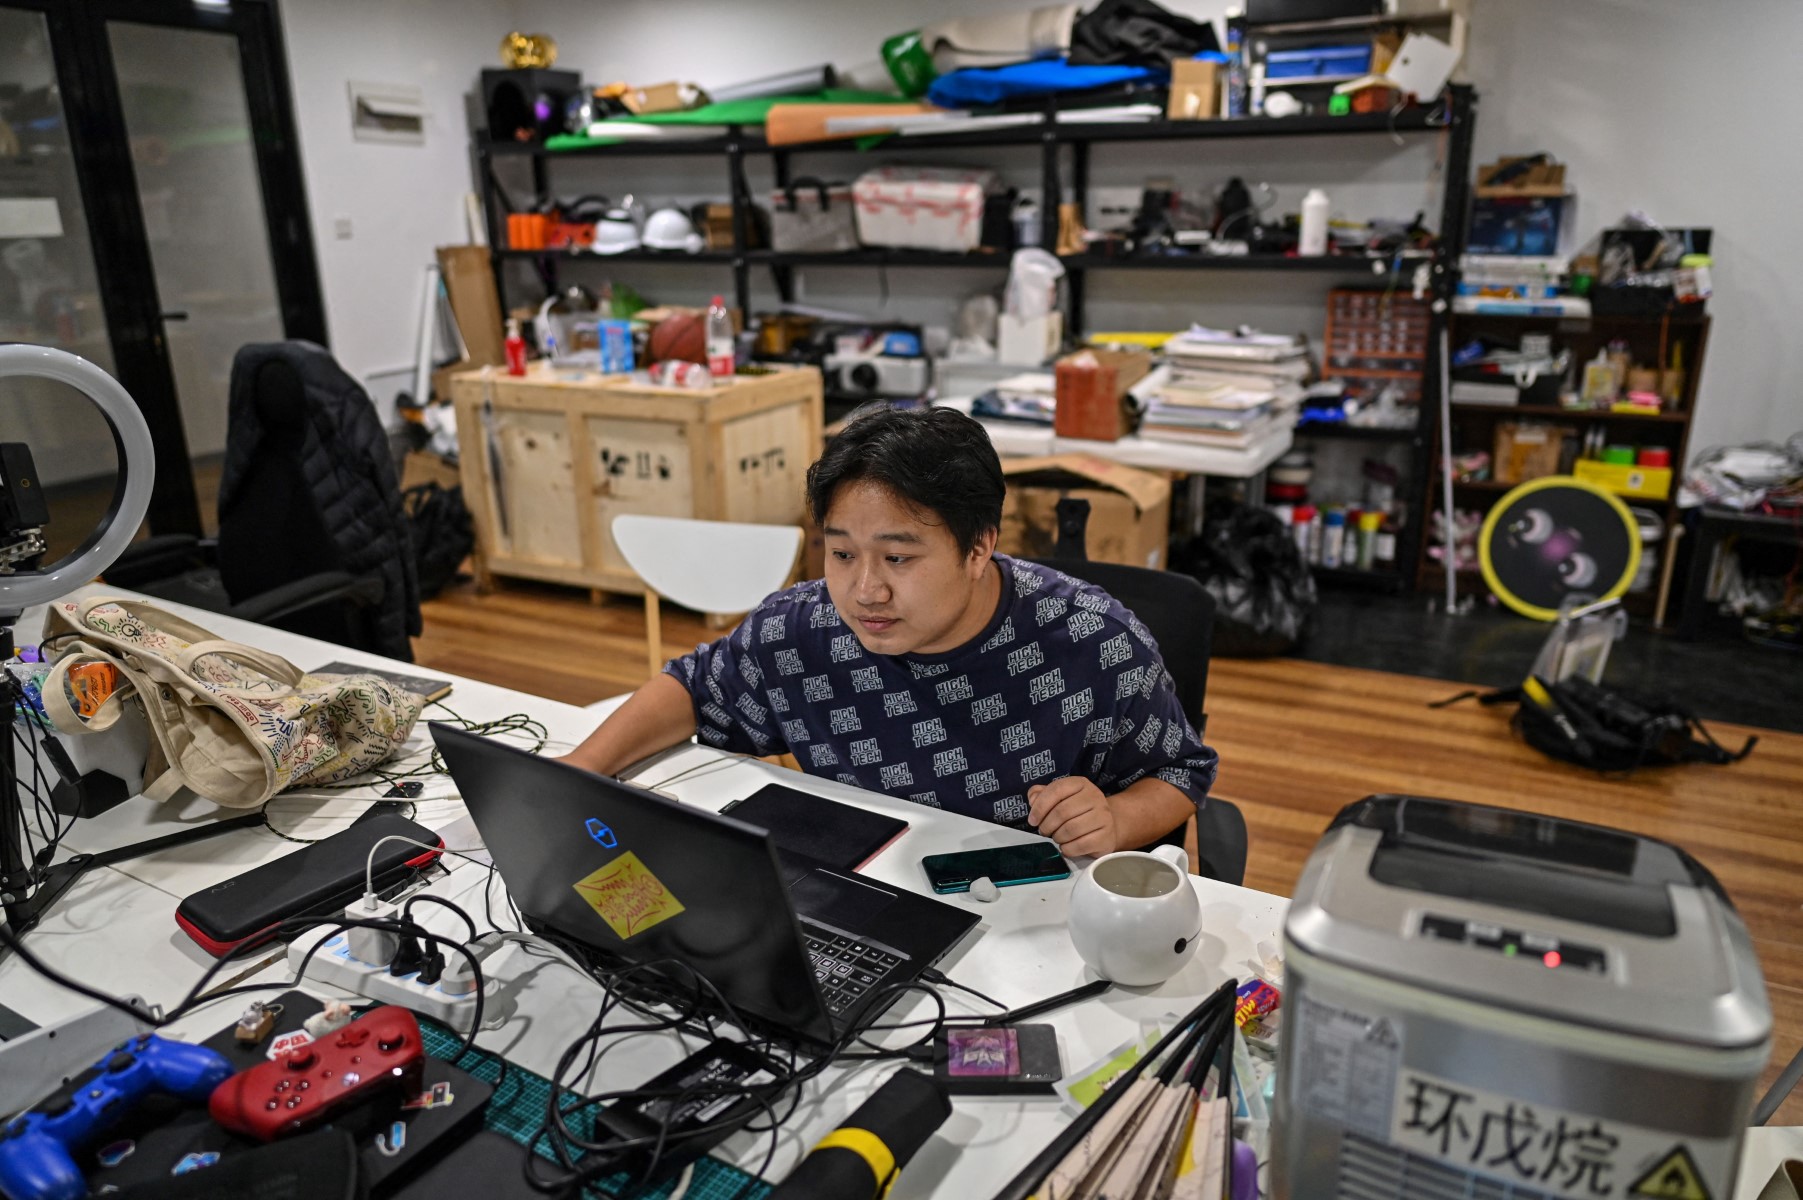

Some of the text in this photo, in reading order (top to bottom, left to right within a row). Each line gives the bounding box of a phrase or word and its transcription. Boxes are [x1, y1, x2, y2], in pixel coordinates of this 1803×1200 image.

[762, 614, 786, 631] HIGH
[810, 614, 840, 628] TECH
[1035, 605, 1068, 627] TECH
[1066, 609, 1097, 630] HIGH
[760, 626, 785, 644] TECH
[1069, 615, 1105, 643] TECH
[832, 633, 857, 650] HIGH
[1099, 632, 1129, 657] HIGH
[774, 648, 799, 664] HIGH
[830, 646, 862, 663] TECH
[1007, 641, 1040, 665] HIGH
[1099, 644, 1133, 670] TECH
[777, 660, 804, 676] TECH
[851, 665, 879, 681] HIGH
[911, 663, 949, 680] TECH
[1007, 651, 1044, 677] TECH
[803, 674, 829, 690] HIGH
[853, 678, 884, 693] TECH
[935, 674, 969, 694] HIGH
[1030, 667, 1062, 692] HIGH
[1117, 665, 1144, 687] HIGH
[804, 686, 834, 703] TECH
[883, 690, 912, 705] HIGH
[937, 685, 974, 706] TECH
[1029, 679, 1066, 705] TECH
[1061, 687, 1093, 712] HIGH
[1116, 680, 1140, 701] TEC
[736, 697, 766, 725] TECH
[741, 691, 767, 716] HIGH
[884, 701, 918, 718] TECH
[971, 693, 1003, 714] HIGH
[1061, 699, 1095, 725] TECH
[830, 706, 857, 722] HIGH
[971, 703, 1008, 726] TECH
[782, 718, 806, 733] HIGH
[830, 717, 862, 735] TECH
[912, 717, 942, 736] HIGH
[1000, 720, 1031, 740] HIGH
[1086, 717, 1113, 734] HIGH
[1134, 713, 1157, 748] HIGH
[850, 737, 878, 754] HIGH
[912, 728, 948, 748] TECH
[1000, 731, 1036, 754] TECH
[1082, 729, 1114, 748] TECH
[1140, 717, 1163, 755] TECH
[809, 743, 833, 755] HIGH
[850, 749, 882, 767] TECH
[933, 746, 964, 766] HIGH
[811, 753, 838, 767] TECH
[880, 762, 909, 778] HIGH
[933, 758, 969, 778] TECH
[1020, 749, 1052, 771] HIGH
[881, 773, 914, 790] TECH
[965, 769, 995, 787] HIGH
[1020, 760, 1056, 783] TECH
[966, 779, 1000, 799] TECH
[993, 794, 1024, 814] HIGH
[1403, 1076, 1620, 1195] 环戊烷
